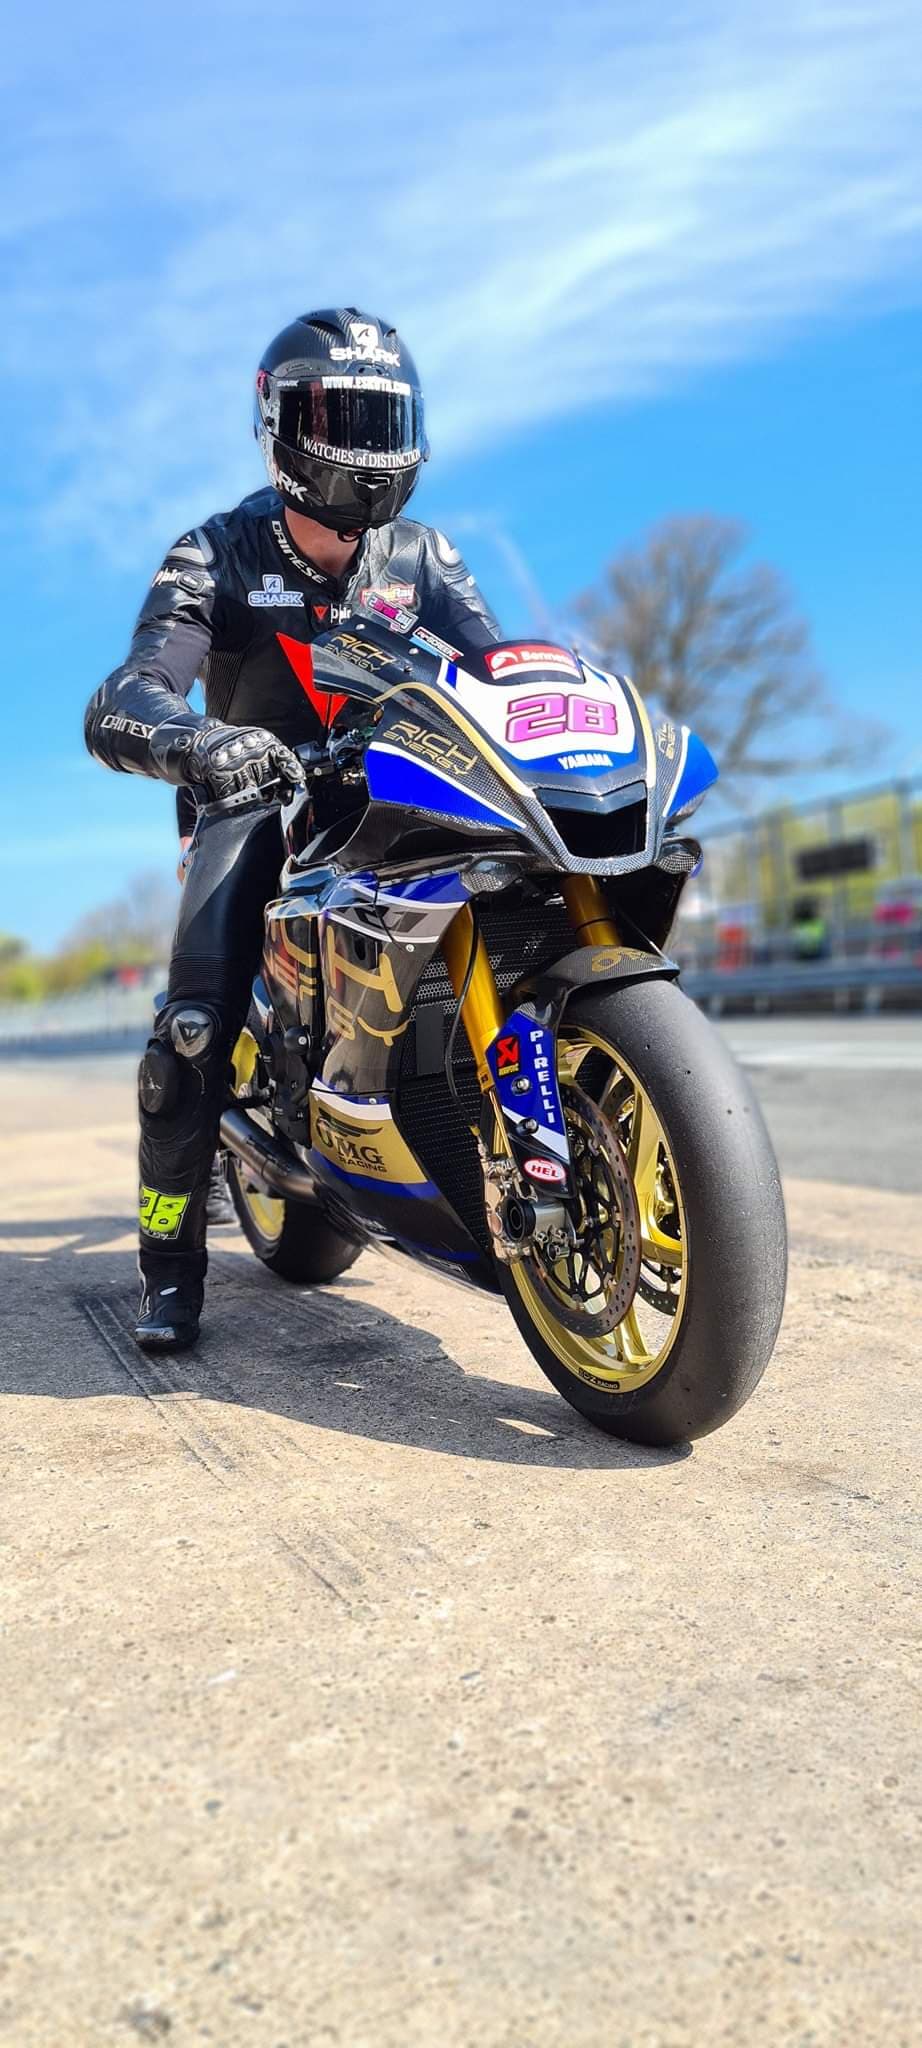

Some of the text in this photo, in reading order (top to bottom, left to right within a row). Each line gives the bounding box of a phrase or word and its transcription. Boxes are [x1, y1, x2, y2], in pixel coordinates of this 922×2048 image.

[330, 346, 401, 367] SHARK
[276, 380, 300, 388] SHARK
[303, 437, 354, 465] WATCHES
[356, 453, 369, 467] of
[271, 520, 328, 584] DAINESE
[250, 593, 302, 605] SHARK
[324, 643, 381, 673] ENERGY
[330, 633, 398, 666] RICH
[520, 650, 577, 669] Benne
[505, 692, 618, 743] 28
[383, 730, 470, 775] ENERGY
[390, 720, 478, 770] RICH
[557, 753, 613, 770] YAMAHA
[530, 1030, 556, 1124] PIRELLI
[336, 1156, 388, 1173] RACING
[531, 1165, 560, 1178] HEL
